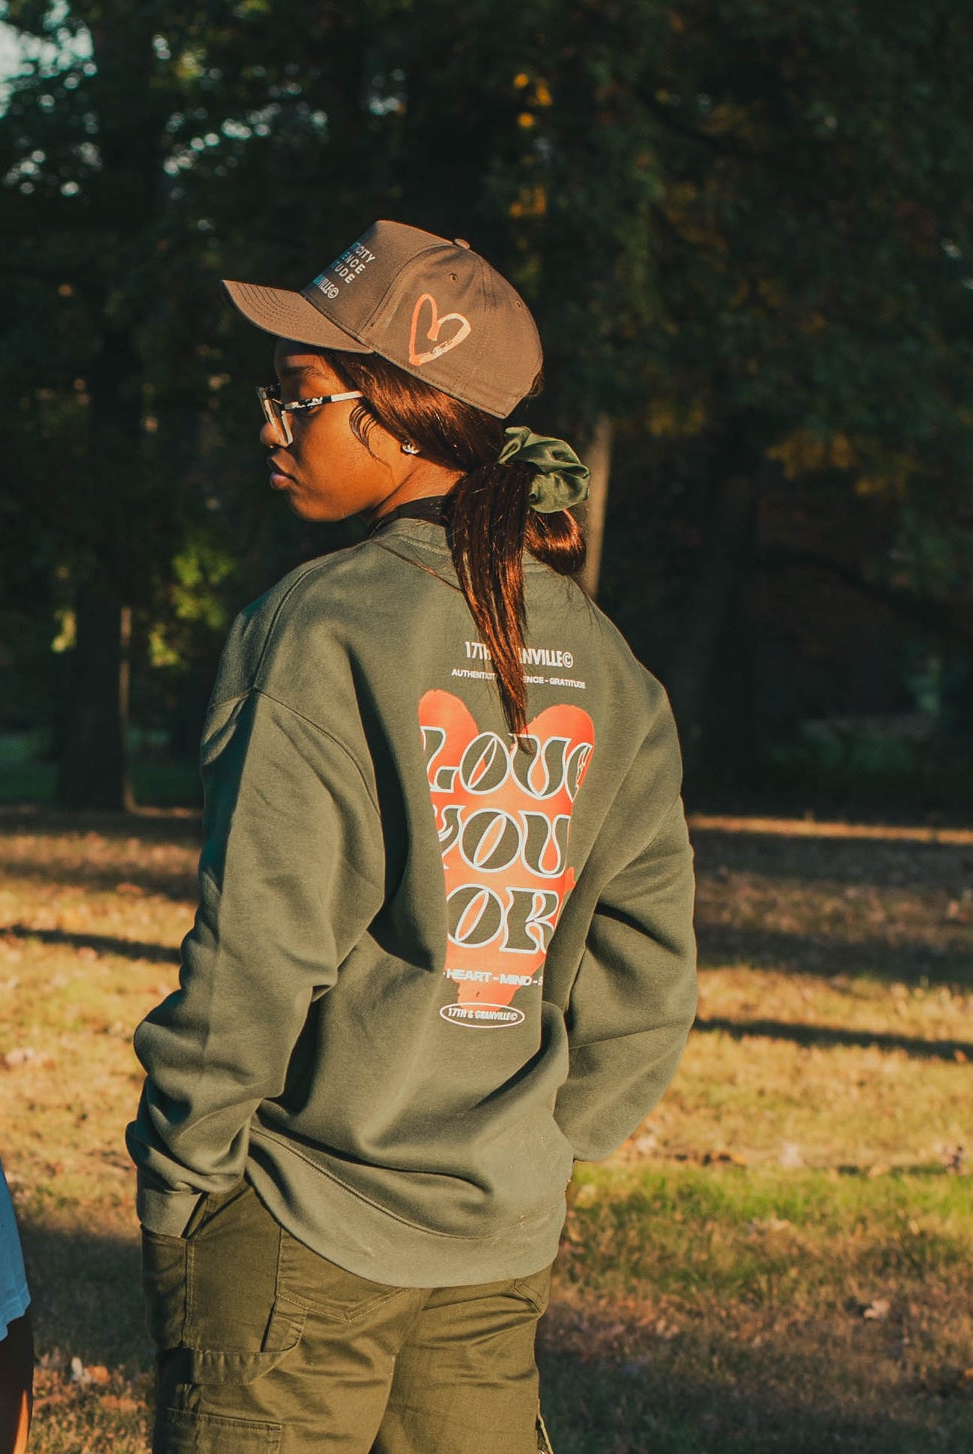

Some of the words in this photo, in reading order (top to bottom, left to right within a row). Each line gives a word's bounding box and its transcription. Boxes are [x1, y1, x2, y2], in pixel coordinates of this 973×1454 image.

[549, 677, 586, 690] GRATITUDE
[446, 968, 493, 983] HEART
[499, 973, 533, 986] MIND
[448, 1008, 467, 1018] 17TH
[468, 1010, 474, 1019] &
